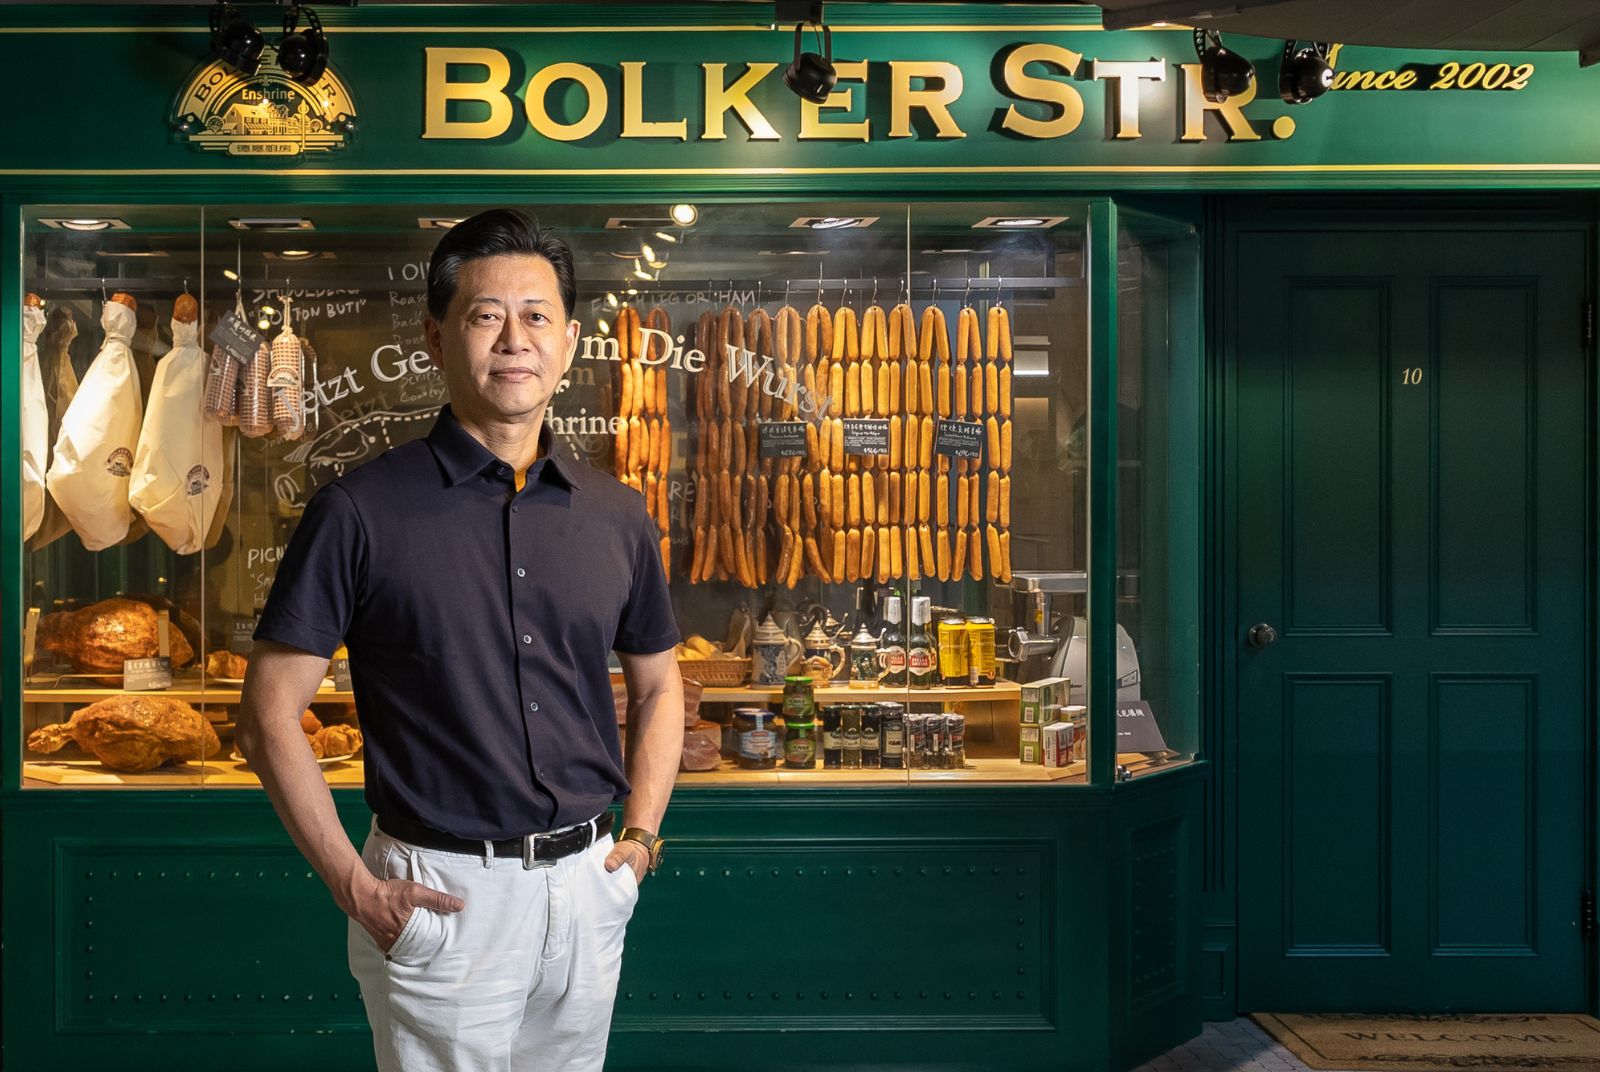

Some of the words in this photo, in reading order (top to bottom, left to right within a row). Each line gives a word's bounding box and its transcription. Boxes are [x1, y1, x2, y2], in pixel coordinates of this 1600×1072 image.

[1430, 61, 1535, 90] 2002
[241, 88, 296, 102] Enshrine
[422, 46, 968, 144] BOLKER
[1002, 43, 1297, 142] STR.
[273, 366, 365, 433] Jetzt
[371, 343, 440, 383] Ge
[638, 327, 706, 373] Die
[725, 343, 833, 420] Wurst
[1402, 367, 1423, 385] 10
[544, 406, 625, 435] hrine
[247, 543, 289, 570] PICN
[1340, 1031, 1575, 1044] WELCOME
